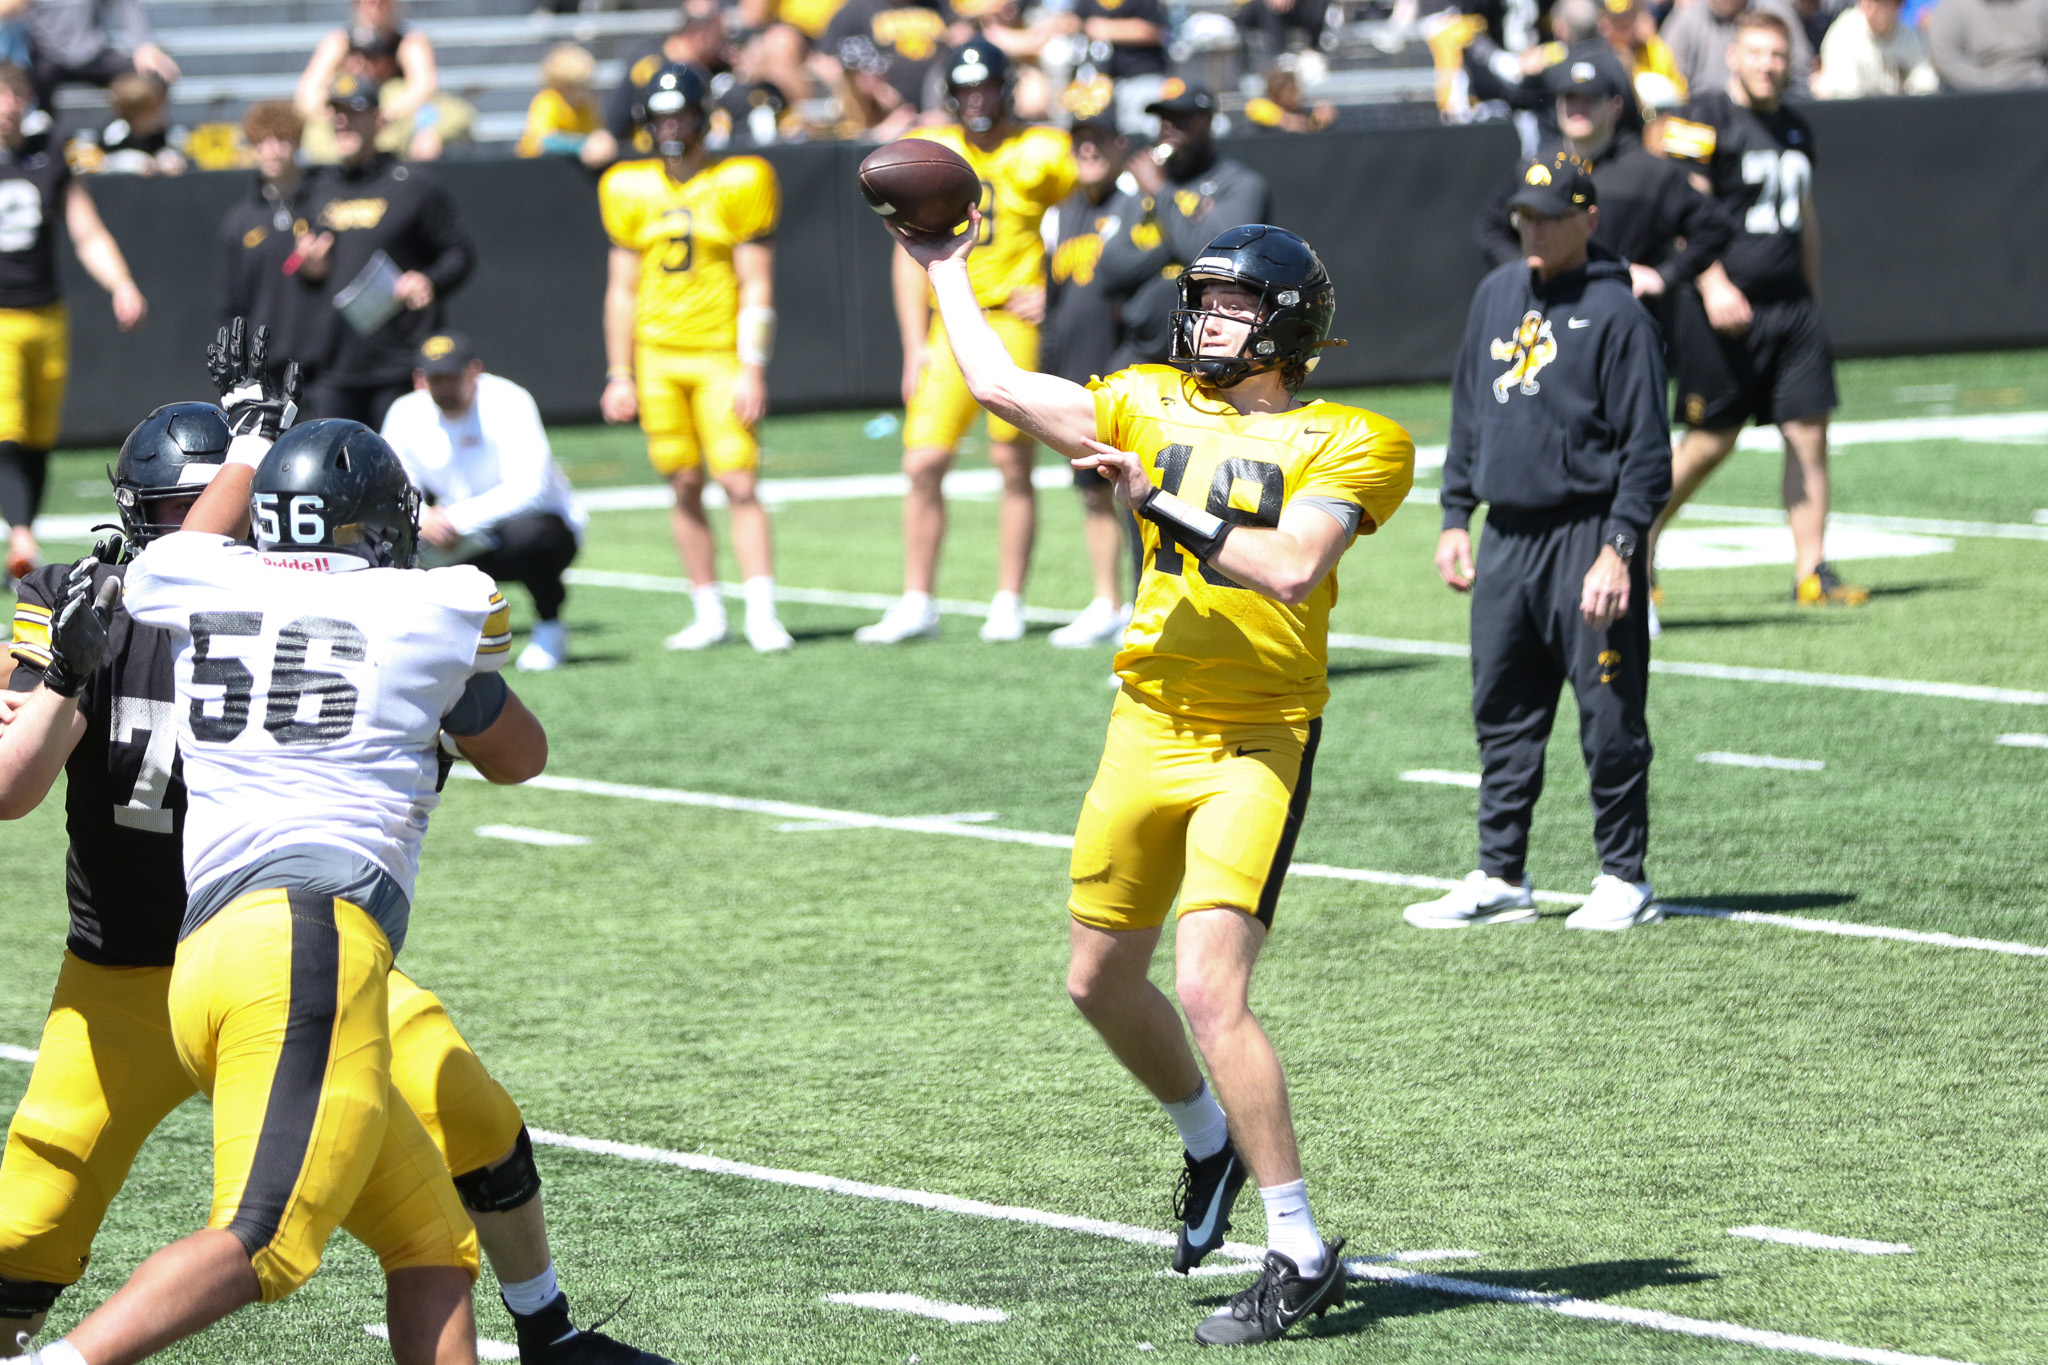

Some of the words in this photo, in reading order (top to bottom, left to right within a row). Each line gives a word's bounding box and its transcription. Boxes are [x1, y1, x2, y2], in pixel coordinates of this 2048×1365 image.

[661, 207, 693, 272] 3
[253, 491, 325, 544] 56
[189, 611, 368, 746] 56
